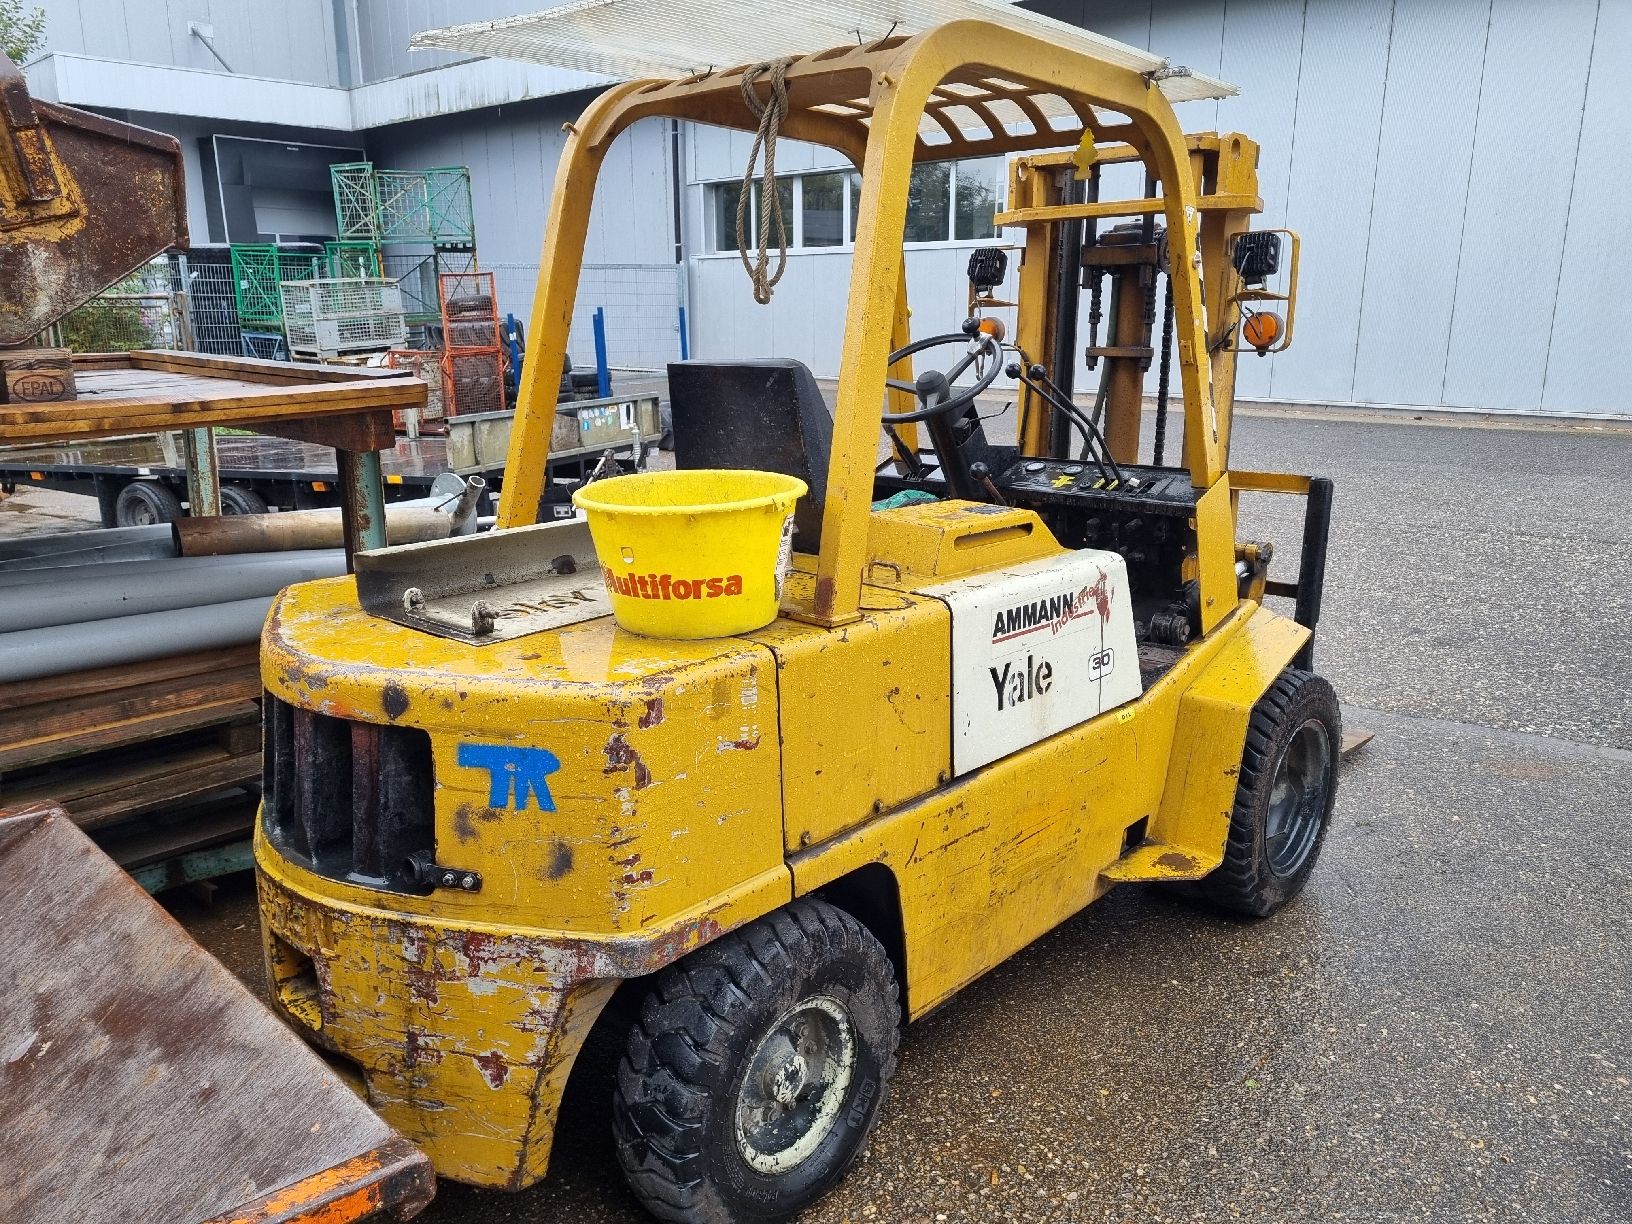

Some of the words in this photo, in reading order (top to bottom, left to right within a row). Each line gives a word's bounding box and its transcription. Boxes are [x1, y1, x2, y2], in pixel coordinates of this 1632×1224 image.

[21, 380, 59, 397] EPAL
[992, 592, 1074, 637] AMMANN
[1091, 652, 1110, 670] 30
[988, 654, 1053, 711] Yale
